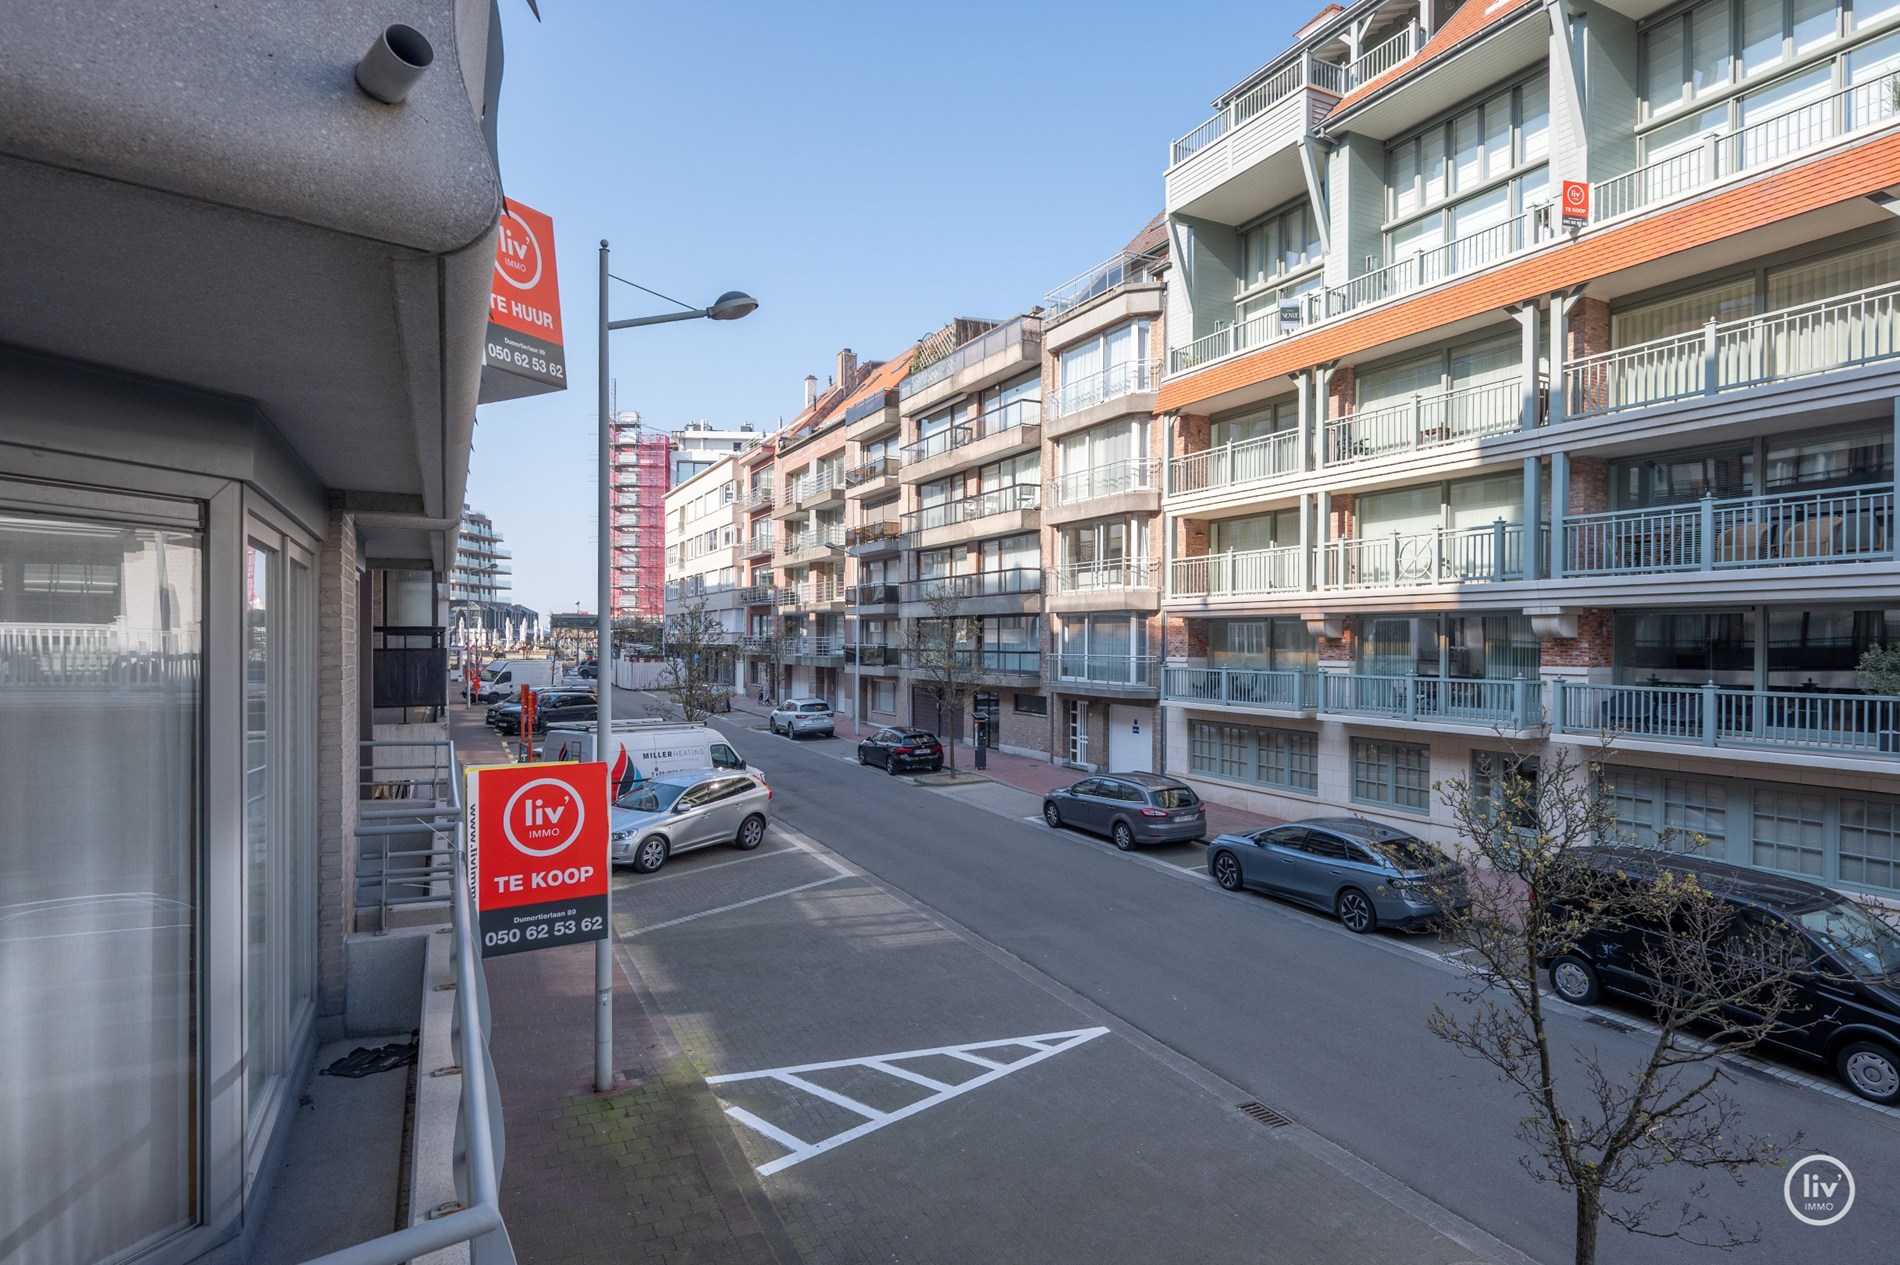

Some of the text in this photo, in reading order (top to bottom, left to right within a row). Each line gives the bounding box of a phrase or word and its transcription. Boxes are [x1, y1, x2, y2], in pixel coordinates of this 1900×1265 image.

[499, 226, 530, 260] liv'
[504, 257, 527, 273] IMMO
[511, 300, 553, 329] HUUR
[488, 343, 564, 379] 050 62 53 62
[525, 796, 570, 827] liv'
[529, 828, 560, 839] IMMO
[494, 866, 594, 894] TE KOOP
[485, 916, 603, 947] 050 62 53 62
[513, 911, 566, 924] Dumortierlaan
